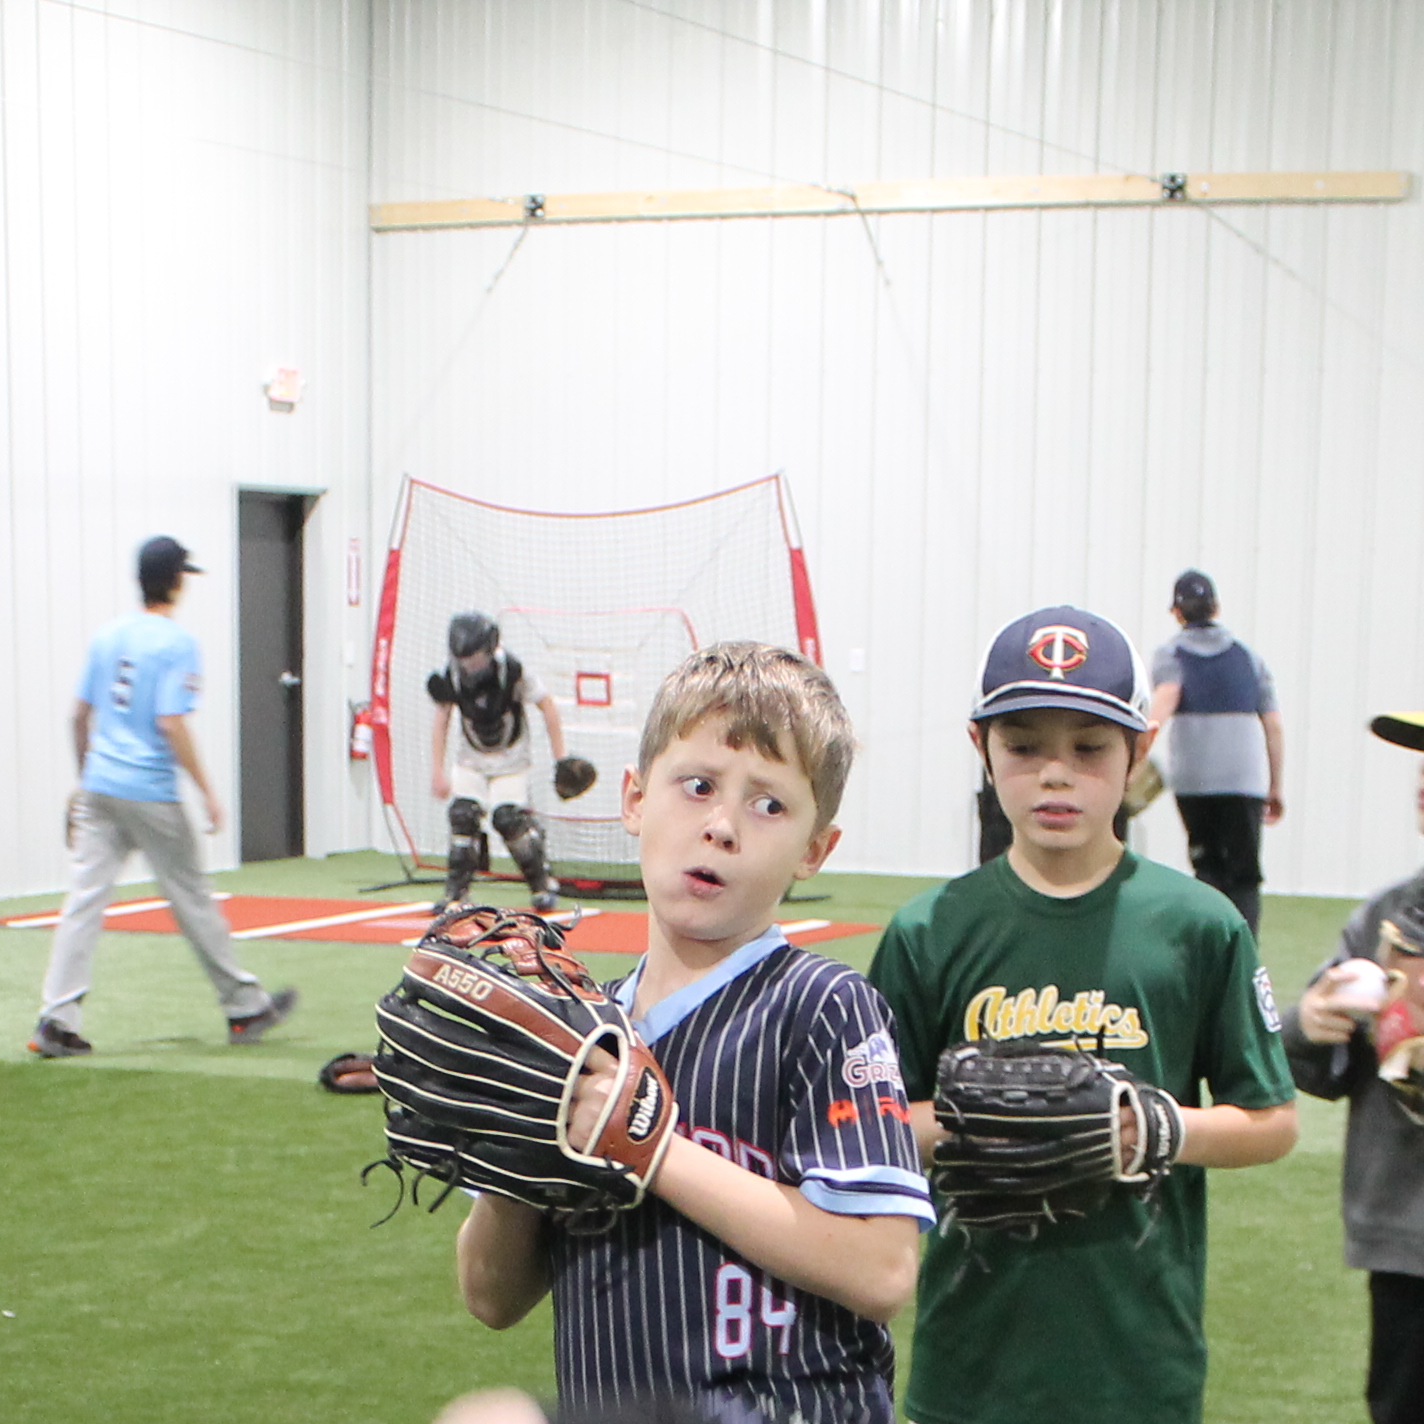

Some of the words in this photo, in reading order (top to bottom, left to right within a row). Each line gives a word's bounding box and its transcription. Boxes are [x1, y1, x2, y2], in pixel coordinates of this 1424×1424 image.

[432, 963, 494, 1001] A550
[964, 984, 1149, 1047] Athletics
[628, 1072, 658, 1136] Wilson
[714, 1261, 797, 1359] 84
